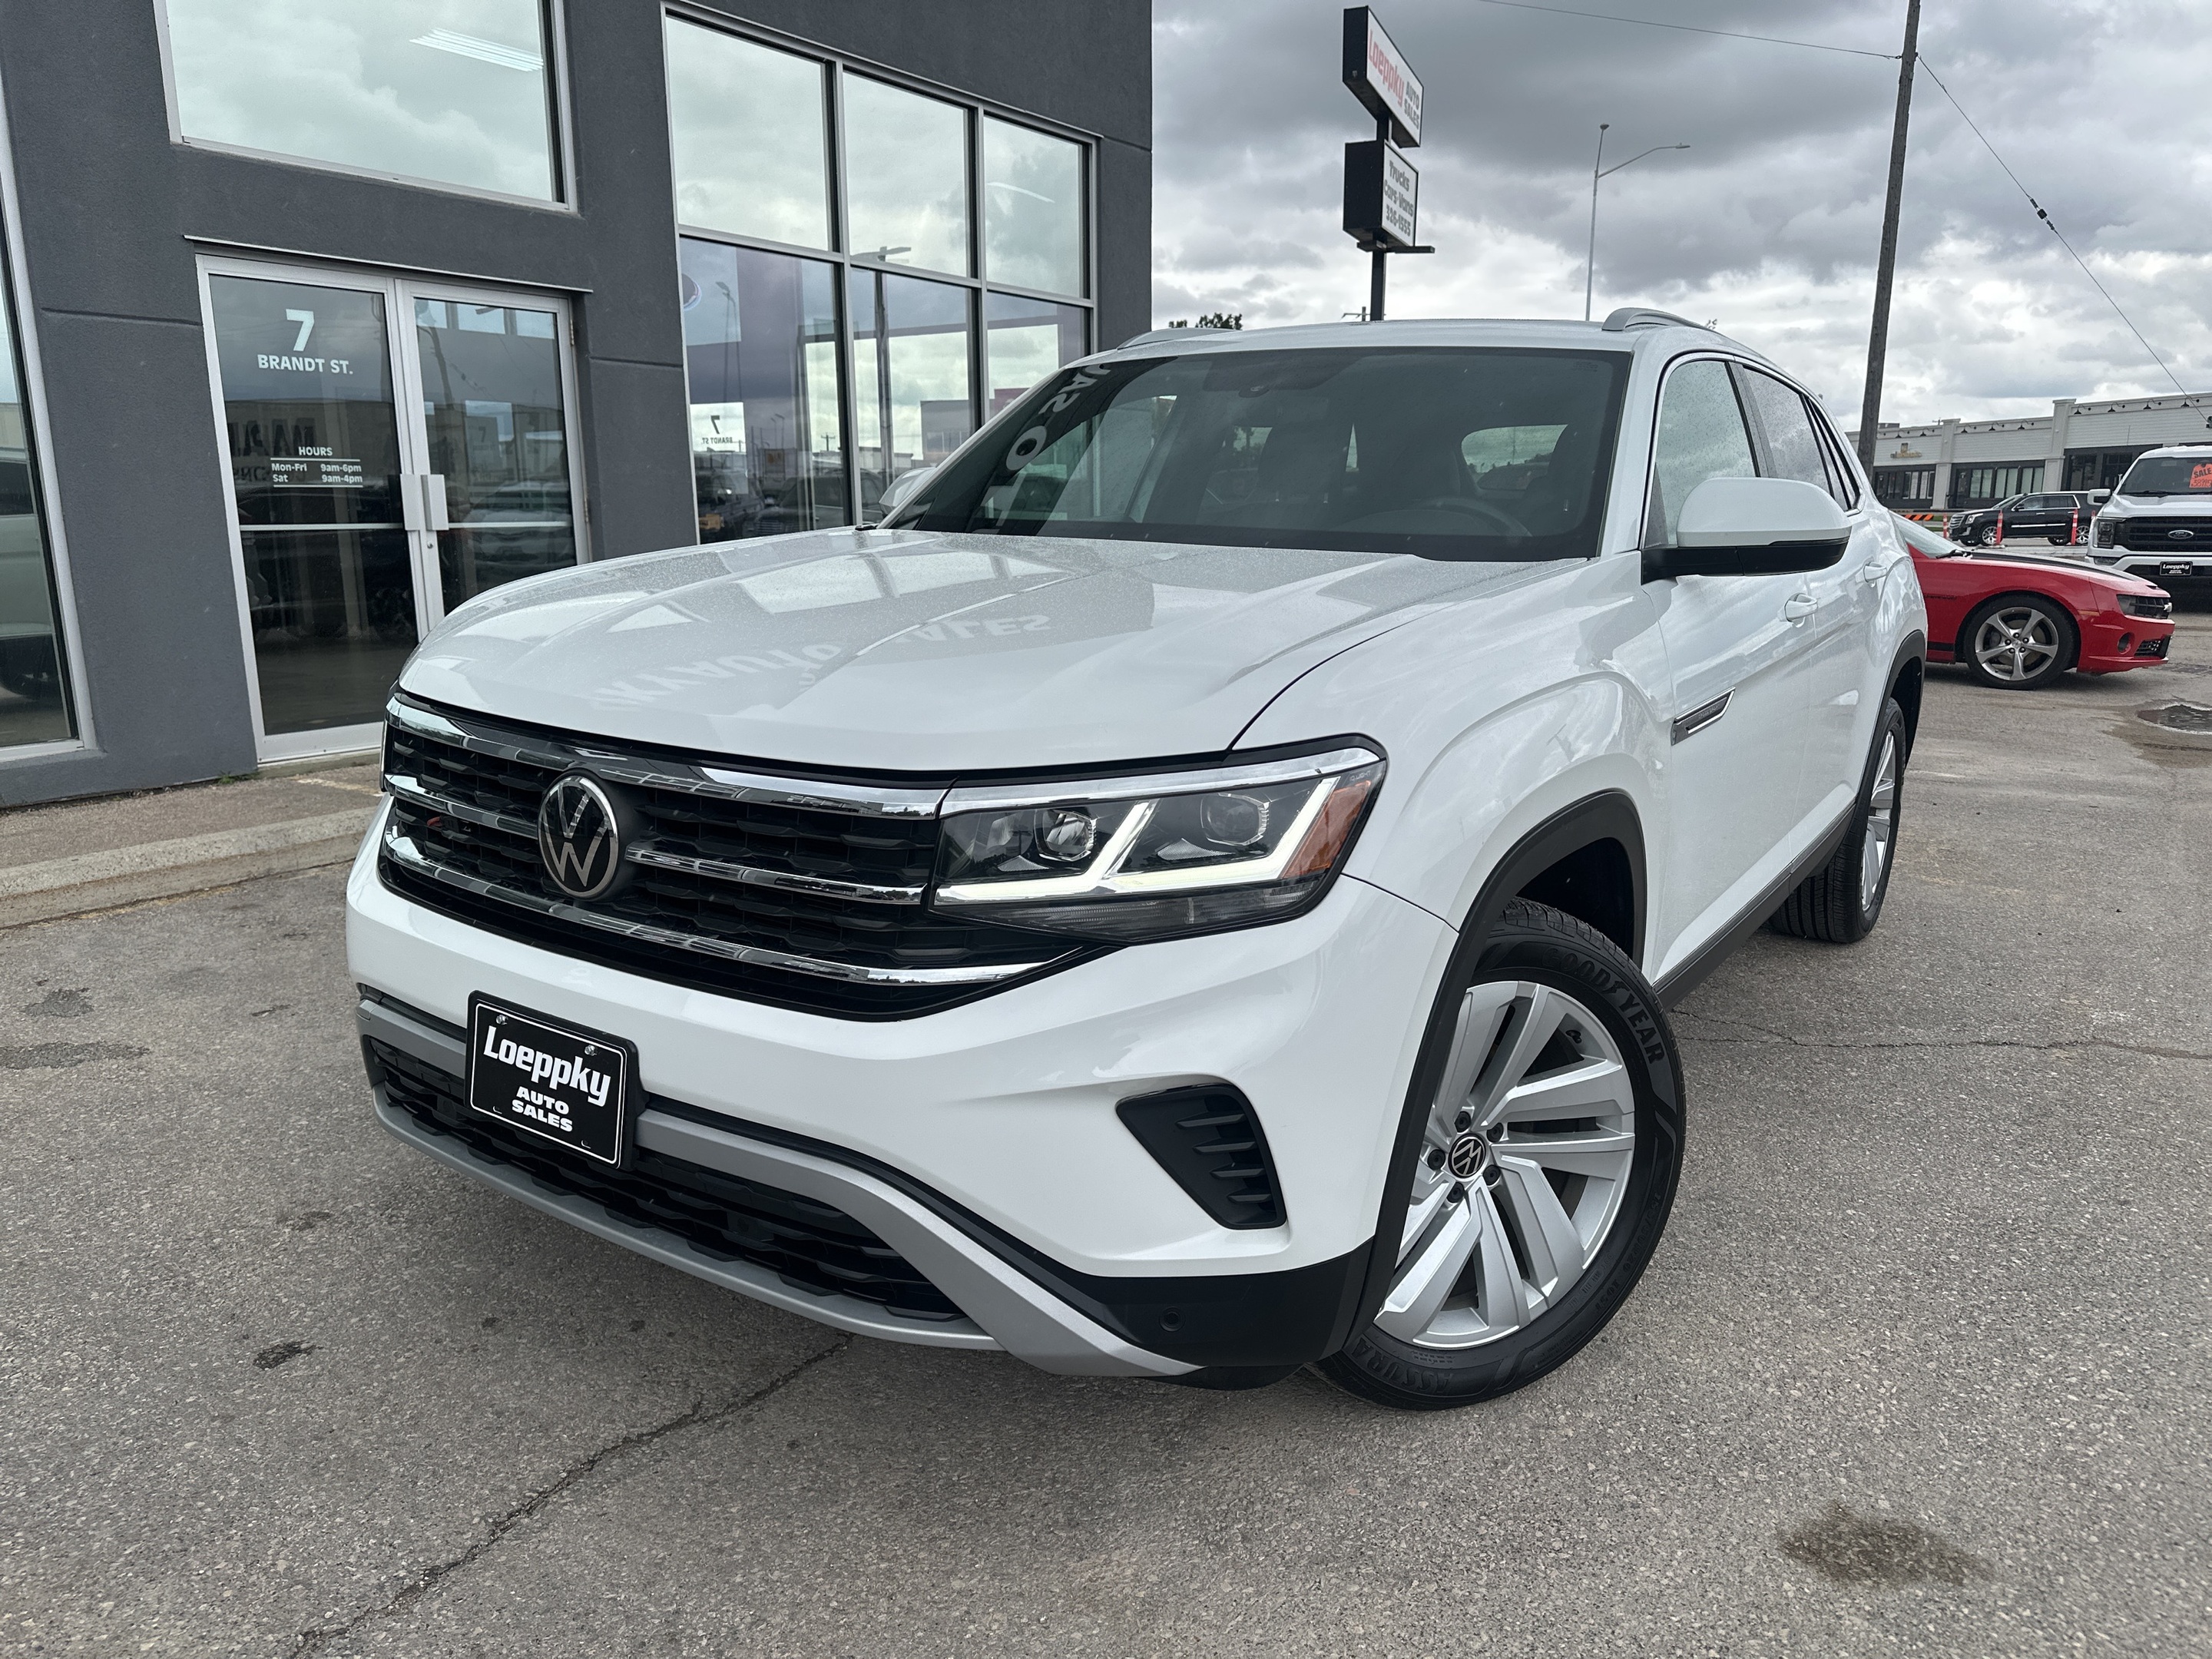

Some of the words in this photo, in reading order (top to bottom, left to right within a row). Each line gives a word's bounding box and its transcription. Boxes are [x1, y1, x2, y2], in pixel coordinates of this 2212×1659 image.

[1369, 29, 1404, 108] Loeppky
[1406, 81, 1419, 110] AUTO
[1404, 98, 1419, 130] SALES
[1389, 160, 1410, 192] Trucks
[1386, 204, 1411, 237] 326-1555
[286, 309, 315, 352] 7
[257, 354, 325, 373] BRANDT
[329, 359, 353, 375] ST.
[298, 446, 333, 456] HOURS
[271, 463, 307, 472] Mon-Fri
[320, 464, 362, 473] 9am-6pm
[273, 474, 289, 482] Sat
[322, 475, 363, 483] 9am-4pm
[2194, 467, 2211, 478] SALE
[1541, 946, 1666, 1065] GOODYEAR
[483, 1025, 611, 1108] Loeppky
[512, 1099, 573, 1132] SALES
[516, 1086, 570, 1115] AUTO
